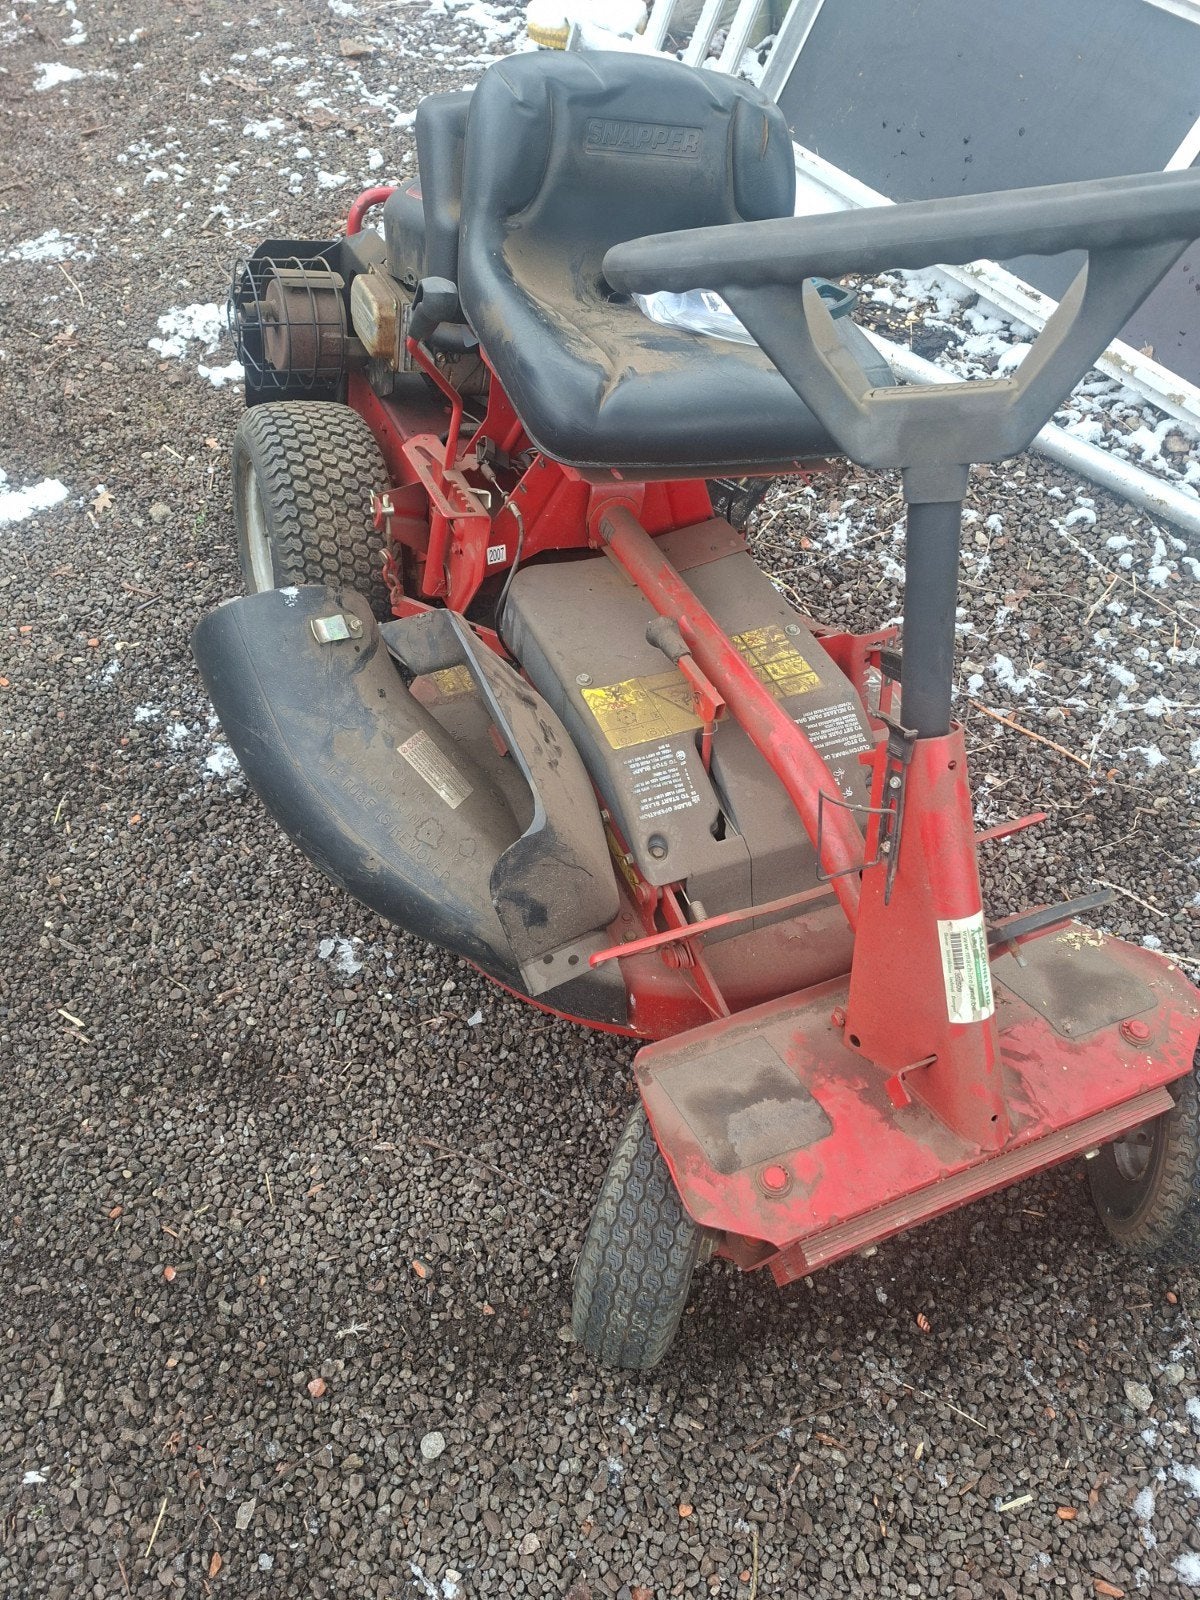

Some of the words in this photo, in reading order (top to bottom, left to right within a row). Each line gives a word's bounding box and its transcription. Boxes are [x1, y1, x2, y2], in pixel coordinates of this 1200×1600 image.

[587, 121, 700, 152] SNAPPER
[489, 547, 504, 562] 2007
[342, 778, 377, 810] TUBE
[374, 811, 391, 827] IS
[391, 824, 450, 881] REMOVED
